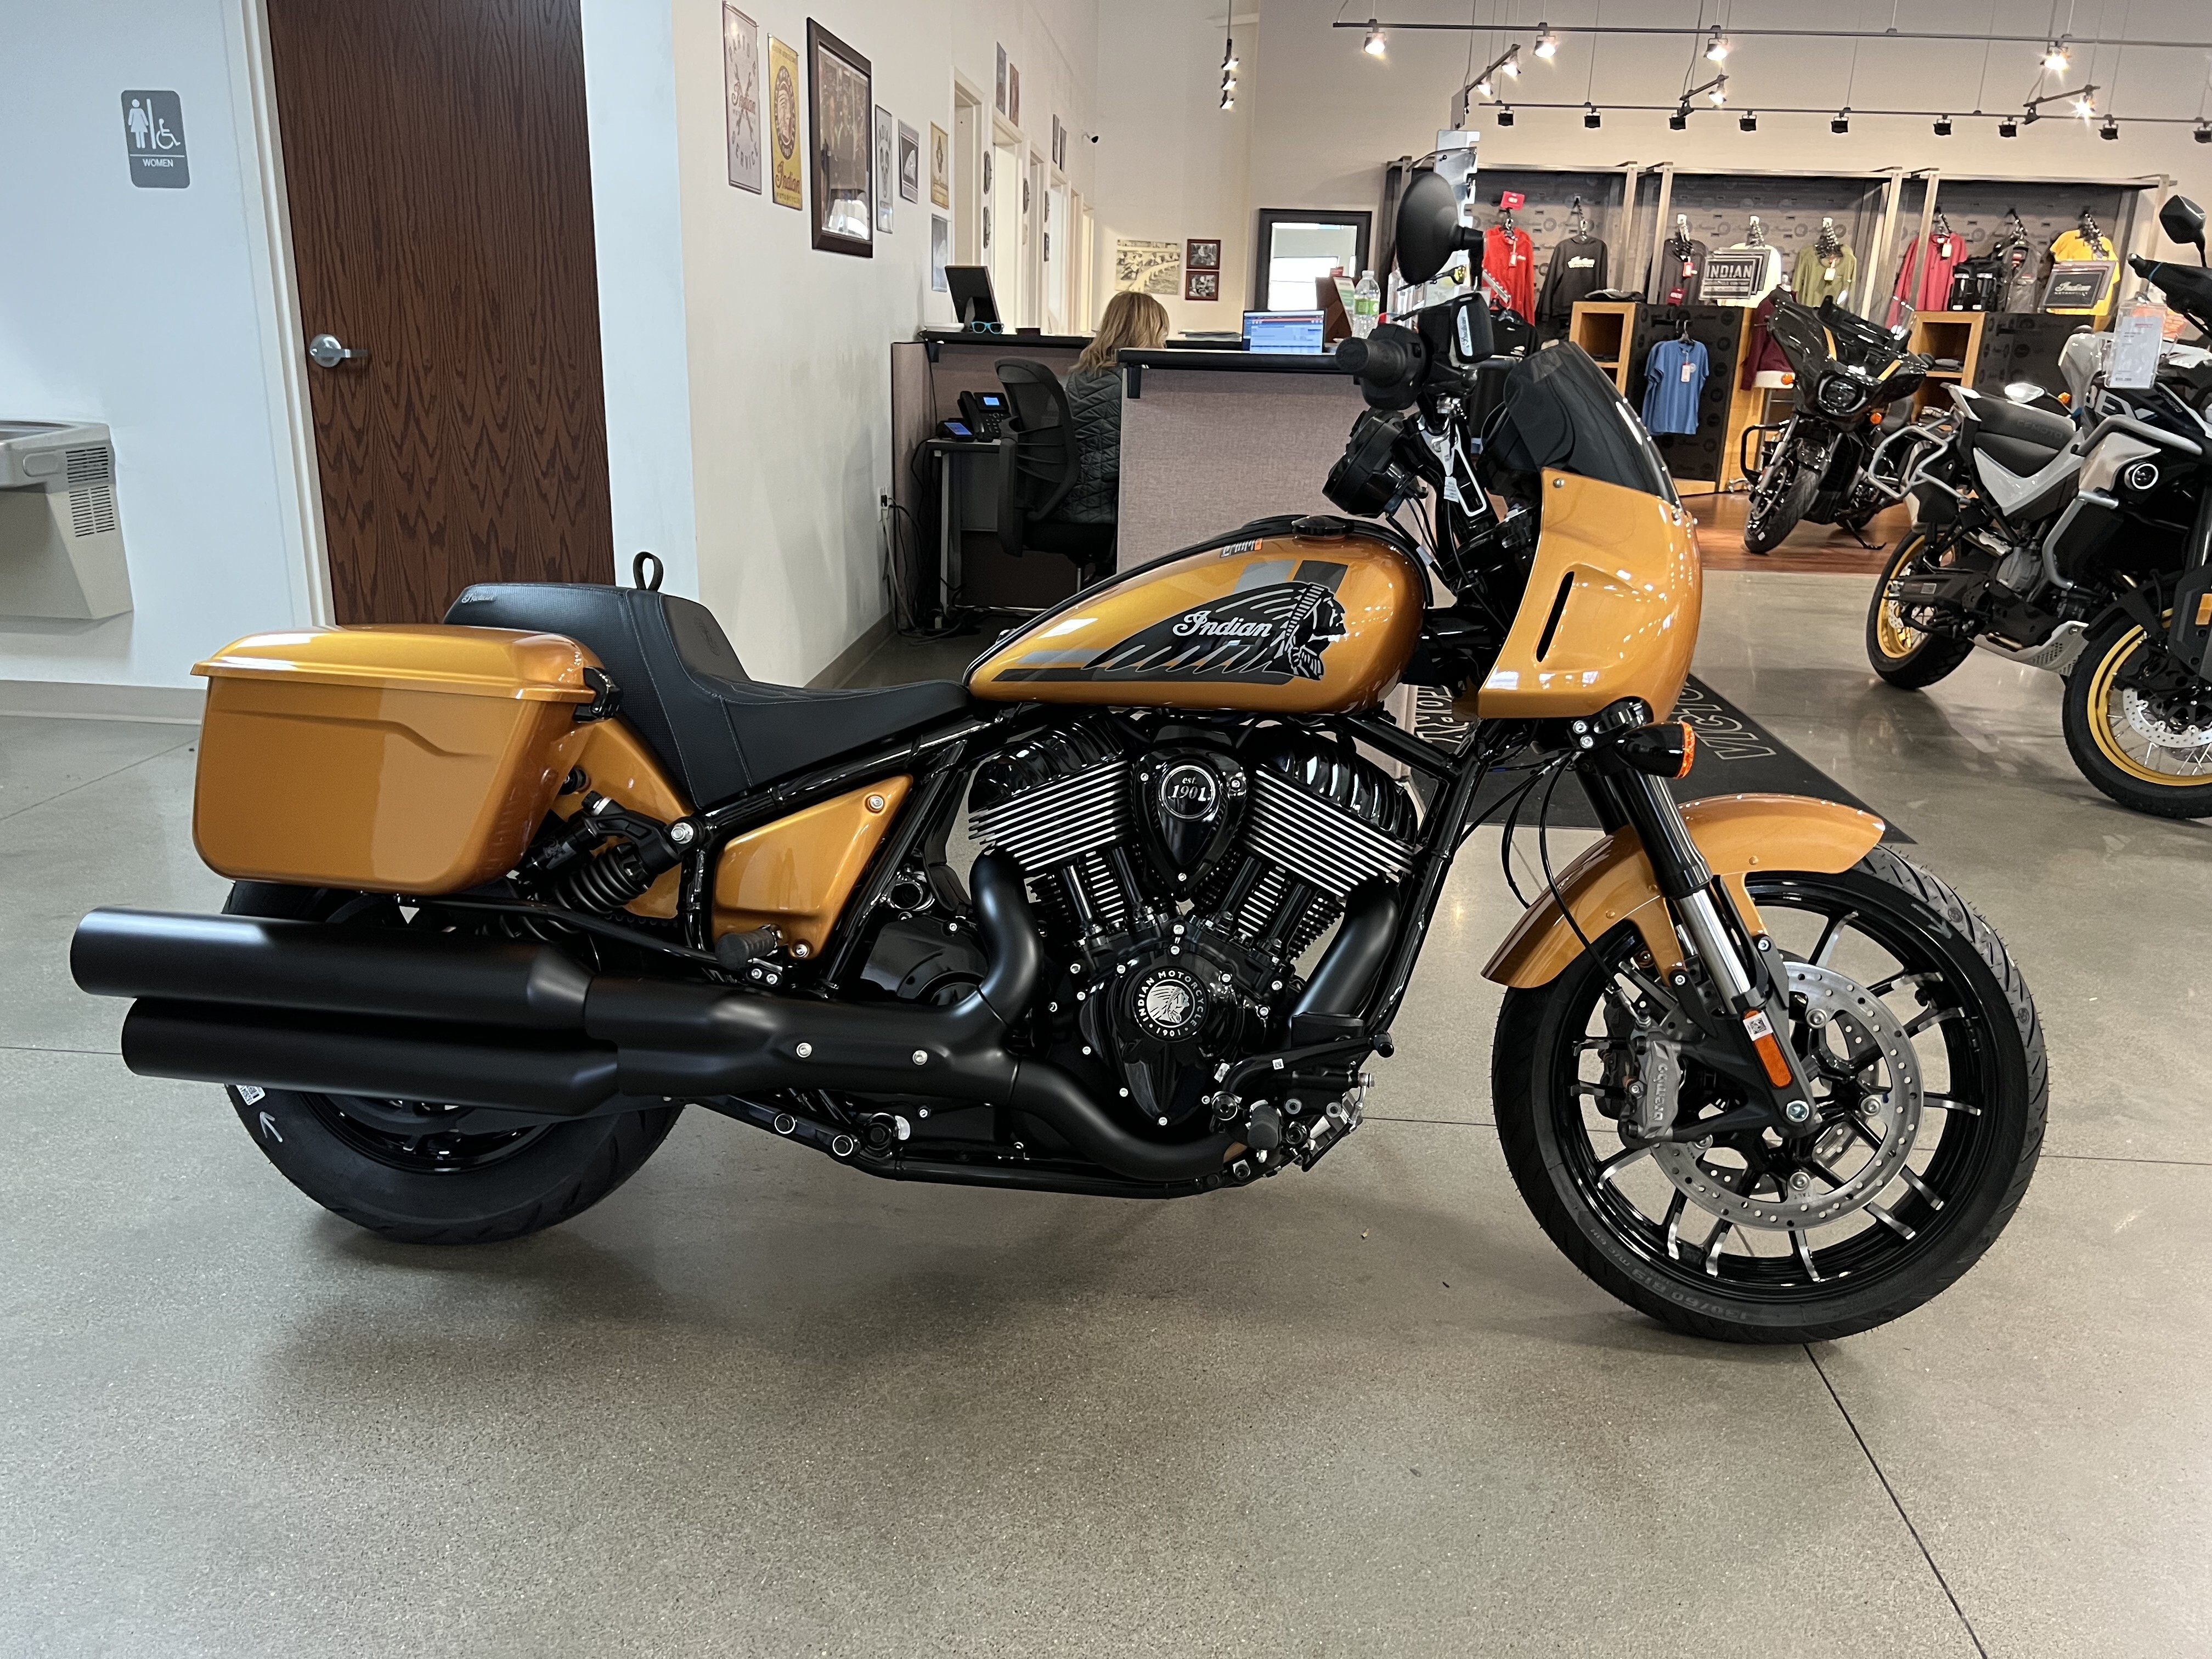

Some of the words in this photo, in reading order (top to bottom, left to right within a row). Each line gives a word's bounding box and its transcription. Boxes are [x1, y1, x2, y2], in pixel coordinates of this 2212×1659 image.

[143, 159, 174, 167] WOMEN
[731, 131, 758, 170] SERVICE
[775, 160, 800, 194] Indian
[1706, 265, 1752, 278] INDIAN
[1172, 610, 1273, 638] Indian
[1171, 785, 1207, 802] 1901
[1182, 776, 1197, 785] est.
[1138, 977, 1155, 1022] INDIAN
[1158, 970, 1204, 1026] MOTORCYCLE
[1156, 1027, 1181, 1037] 1901
[1649, 1063, 1668, 1121] brembo
[1671, 1291, 1747, 1319] 130/60
